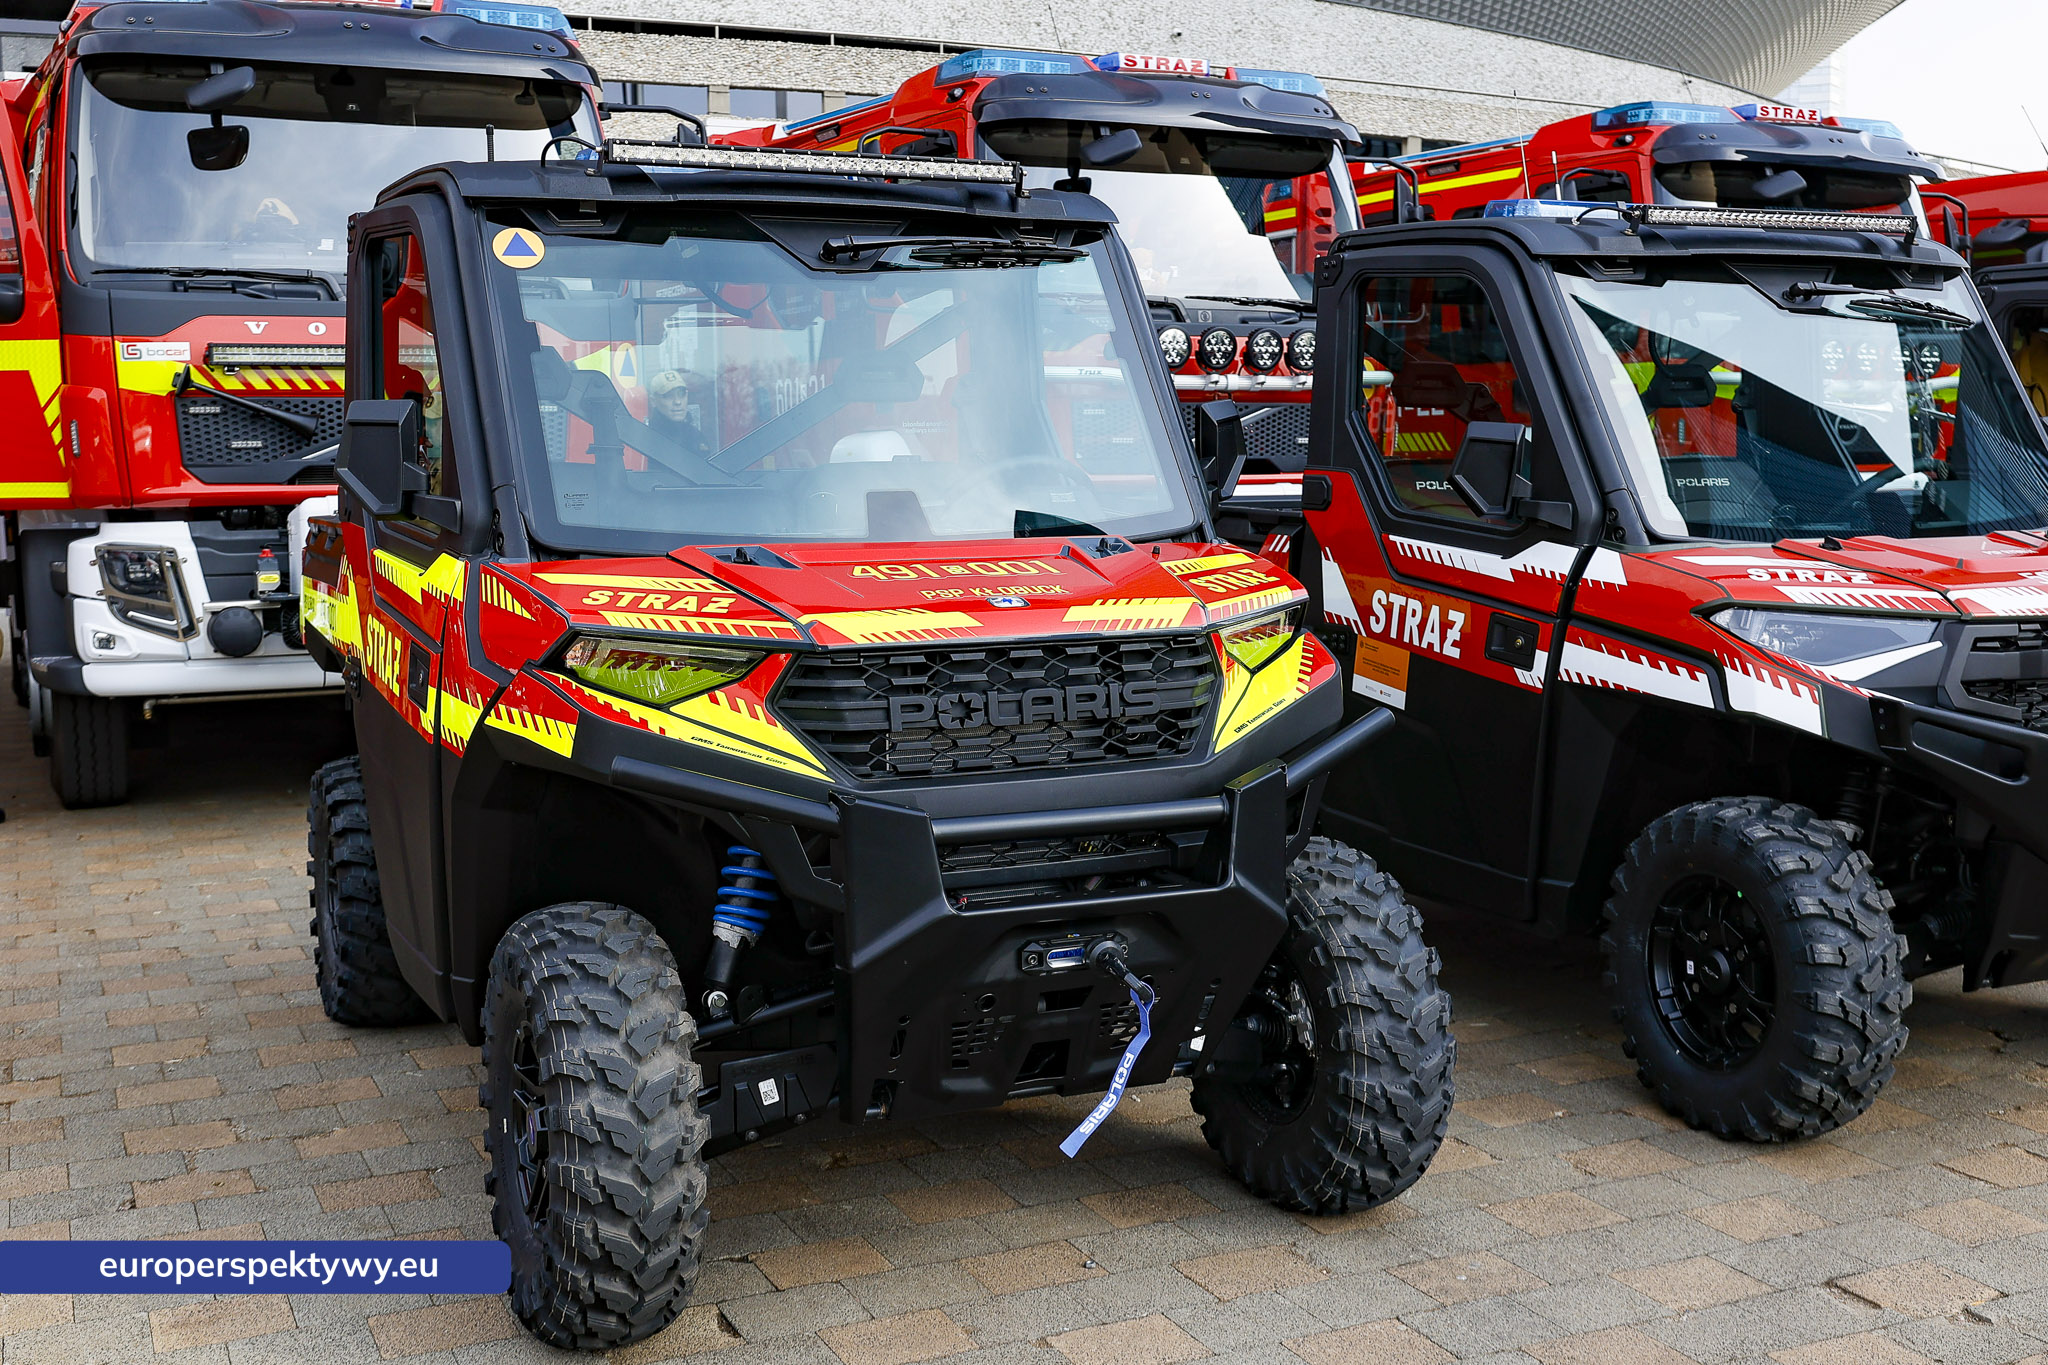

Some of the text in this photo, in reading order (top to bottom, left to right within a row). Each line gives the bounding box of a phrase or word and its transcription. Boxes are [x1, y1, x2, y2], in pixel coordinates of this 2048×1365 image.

[146, 347, 188, 356] bocar
[1675, 477, 1731, 487] POLARIS
[920, 588, 965, 600] PSP
[888, 679, 1162, 733] POLARIS
[1079, 1051, 1135, 1136] POLARIS
